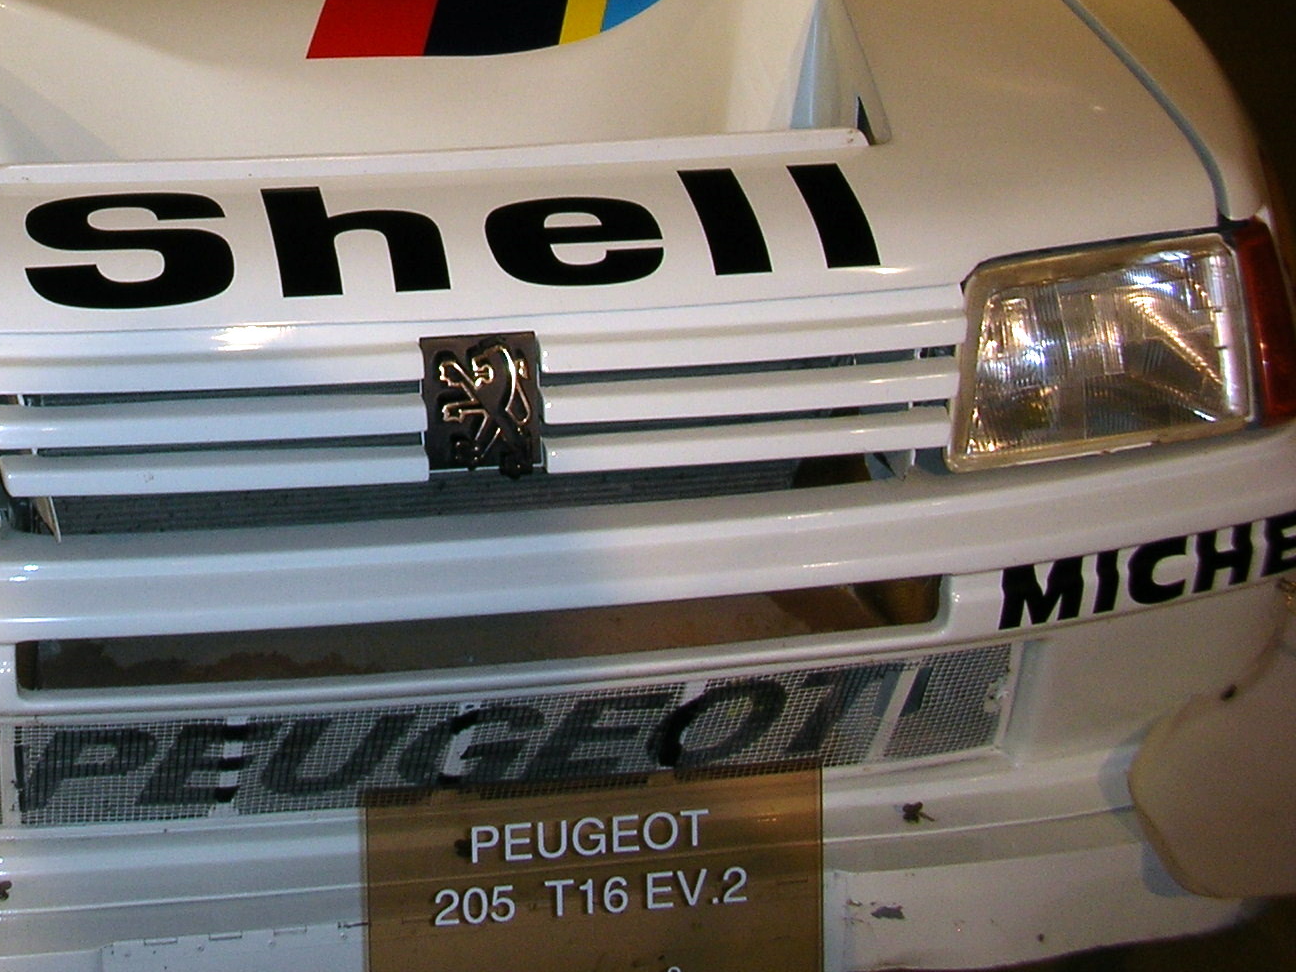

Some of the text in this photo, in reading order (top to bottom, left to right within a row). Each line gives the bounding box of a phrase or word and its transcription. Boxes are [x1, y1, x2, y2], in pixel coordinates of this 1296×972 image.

[24, 163, 881, 309] Shell
[17, 662, 932, 812] PEUGEOT
[470, 809, 710, 864] PEUGEOT
[434, 866, 749, 927] 205 T16 EV.2
